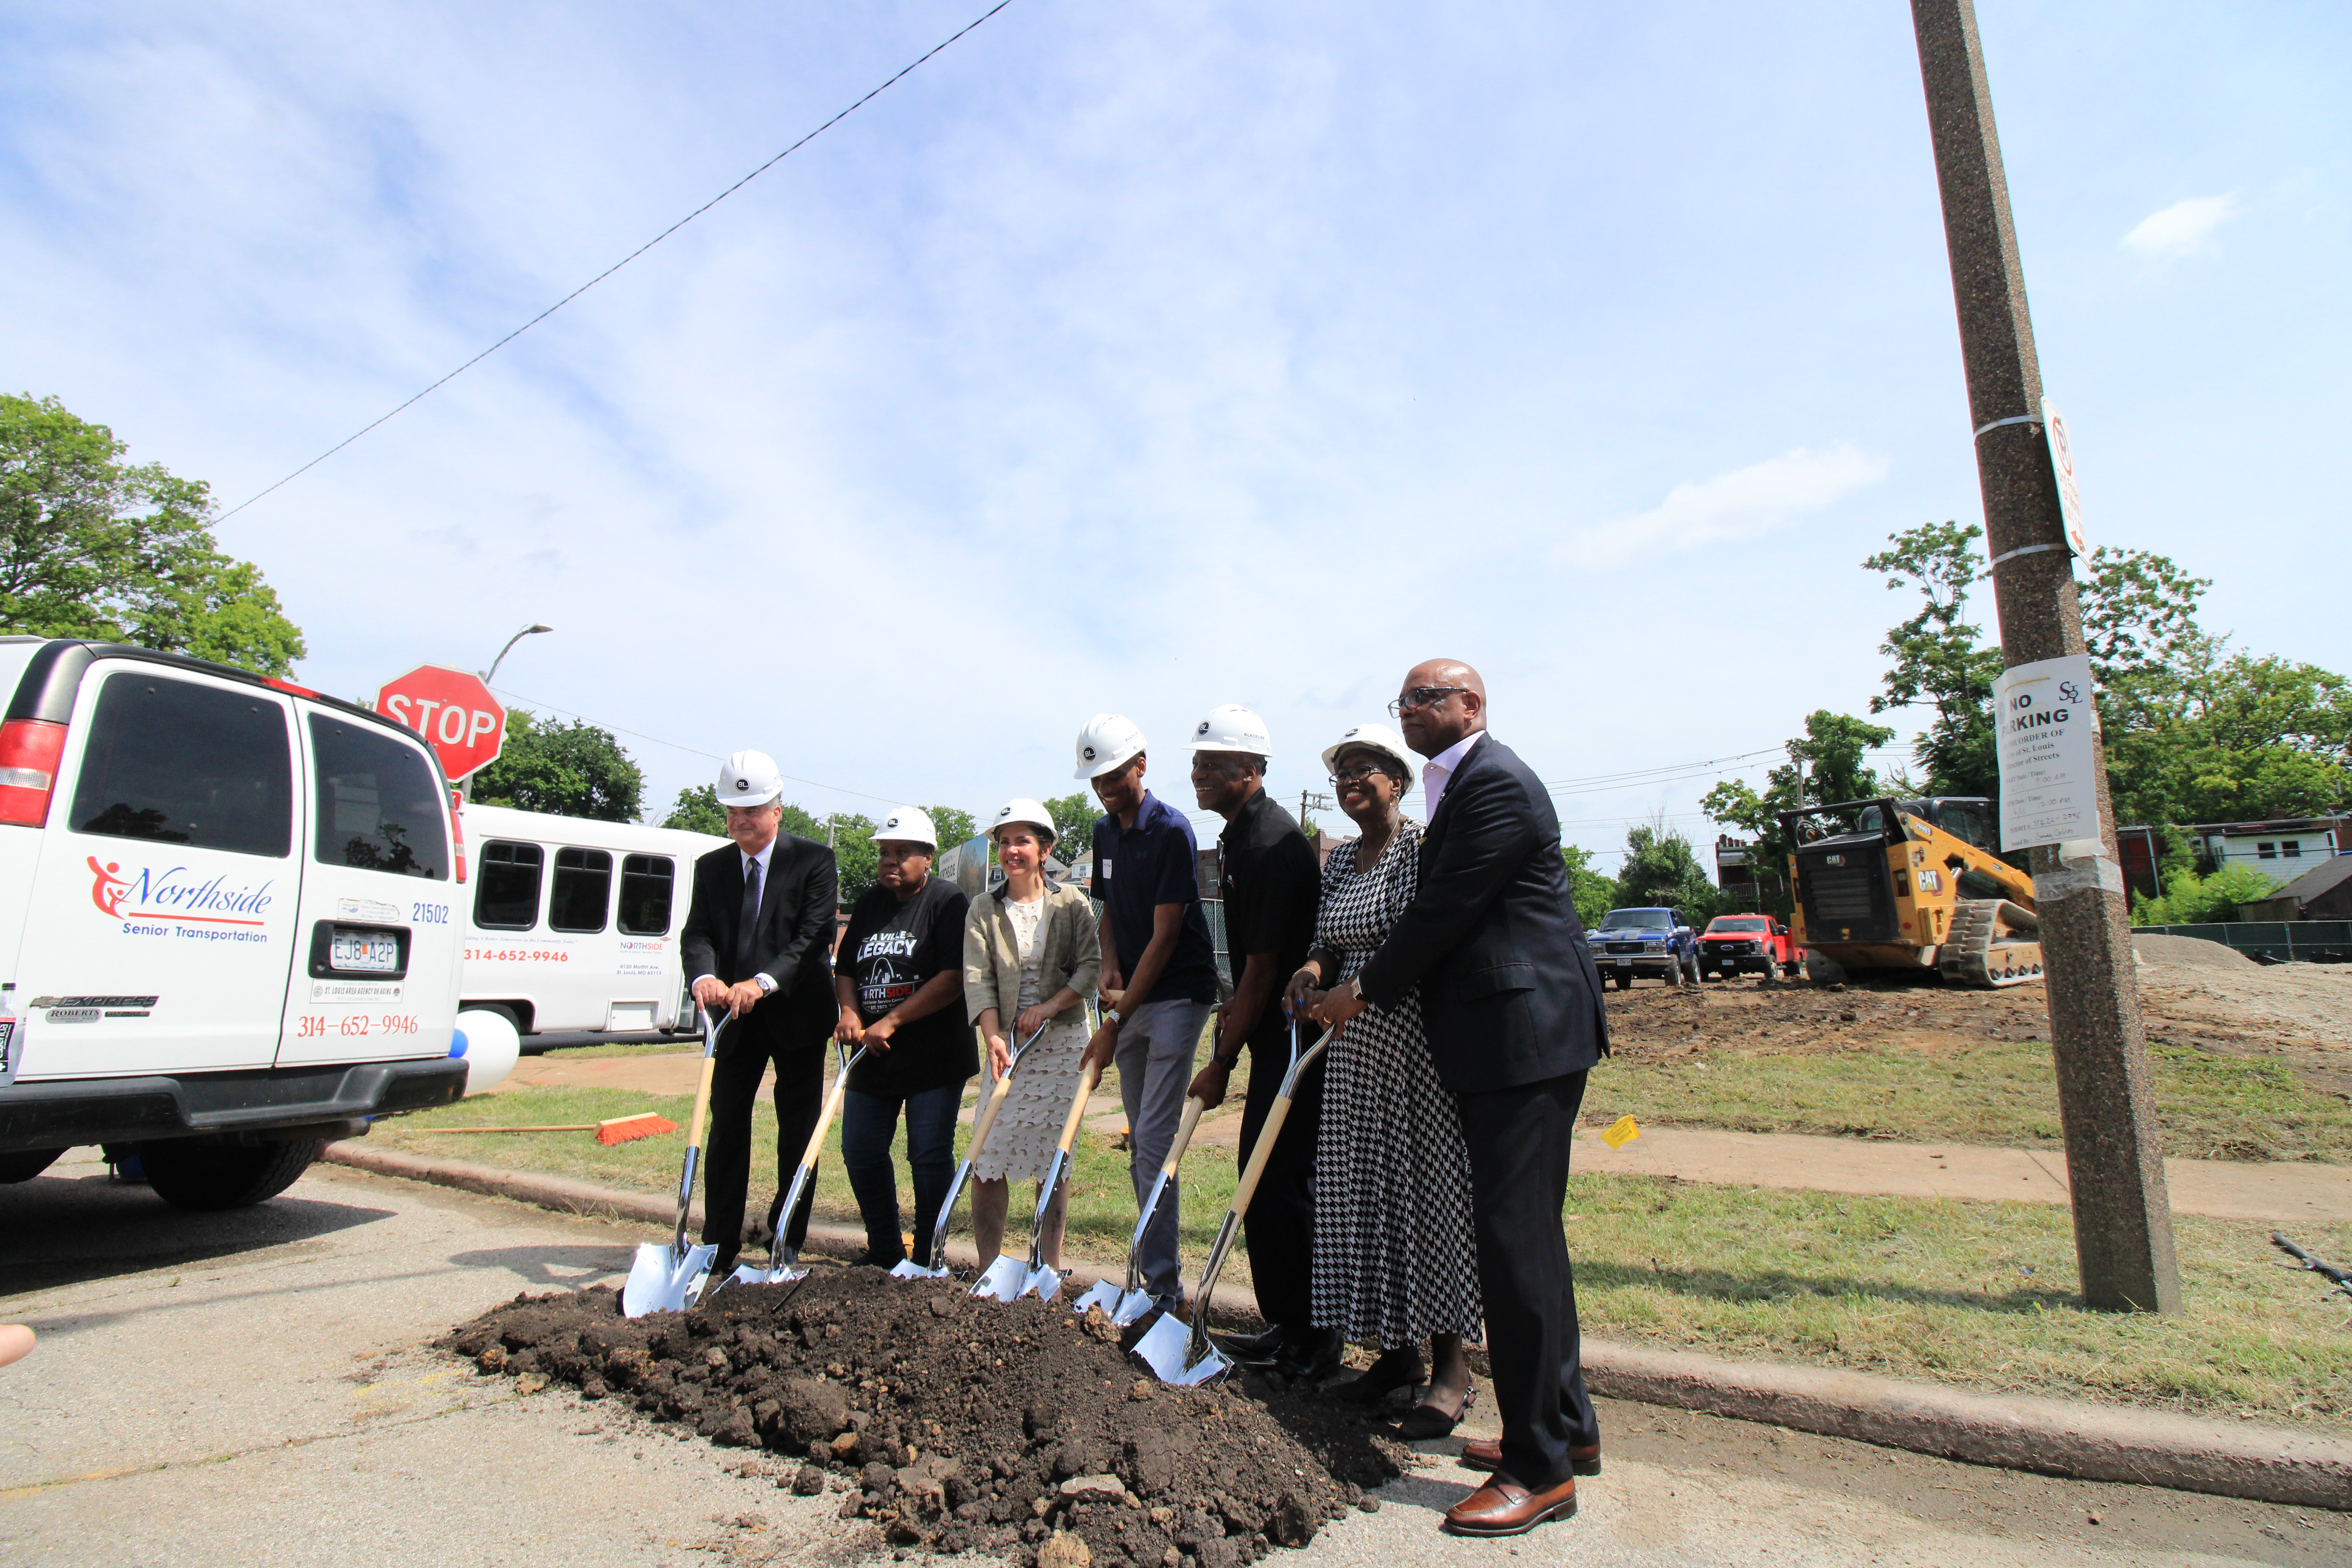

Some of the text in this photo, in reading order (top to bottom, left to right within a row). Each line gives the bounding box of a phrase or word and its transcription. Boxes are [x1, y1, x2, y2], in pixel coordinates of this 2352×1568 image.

[2009, 695, 2031, 711] NO
[387, 694, 496, 748] STOP
[2002, 709, 2069, 738] PARKING
[2018, 732, 2048, 744] ORDER
[2050, 729, 2064, 737] OF
[2032, 742, 2054, 751] Louis
[2033, 753, 2060, 762] Streets
[2010, 825, 2025, 833] PERMIT
[1827, 855, 1840, 864] CAT
[1918, 870, 1937, 892] CAT
[116, 867, 275, 914] Northside
[412, 902, 448, 924] 21502
[123, 923, 267, 942] Senior Transportation
[869, 930, 906, 942] A VILLE
[335, 938, 394, 962] EJ8 A2P
[464, 949, 568, 962] 314-652-9946
[857, 939, 917, 963] LEGACY
[57, 996, 160, 1007] EXPRESS
[298, 1015, 418, 1037] 314-652-9946
